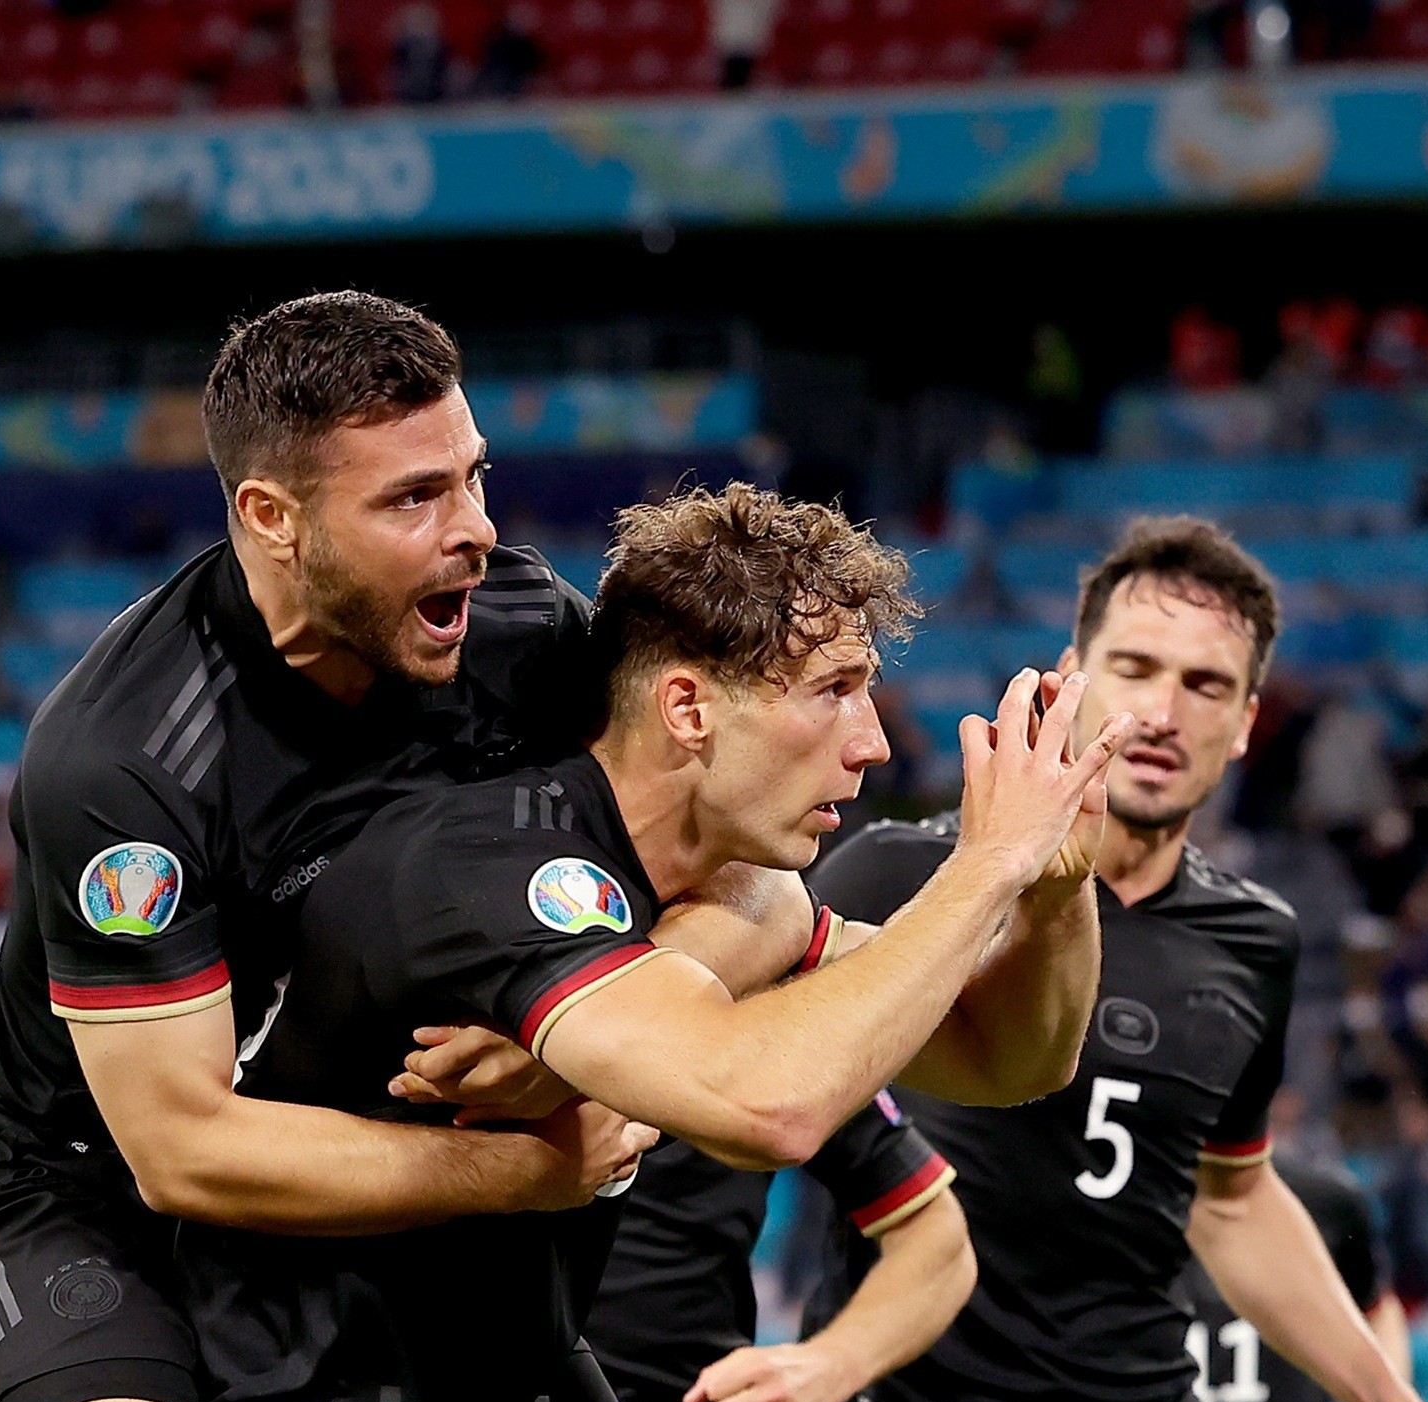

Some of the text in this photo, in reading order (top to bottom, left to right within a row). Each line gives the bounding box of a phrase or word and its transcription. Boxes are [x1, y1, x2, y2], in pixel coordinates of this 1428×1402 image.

[221, 130, 437, 226] 2020
[272, 855, 330, 903] adidas
[1074, 1076, 1142, 1199] 5
